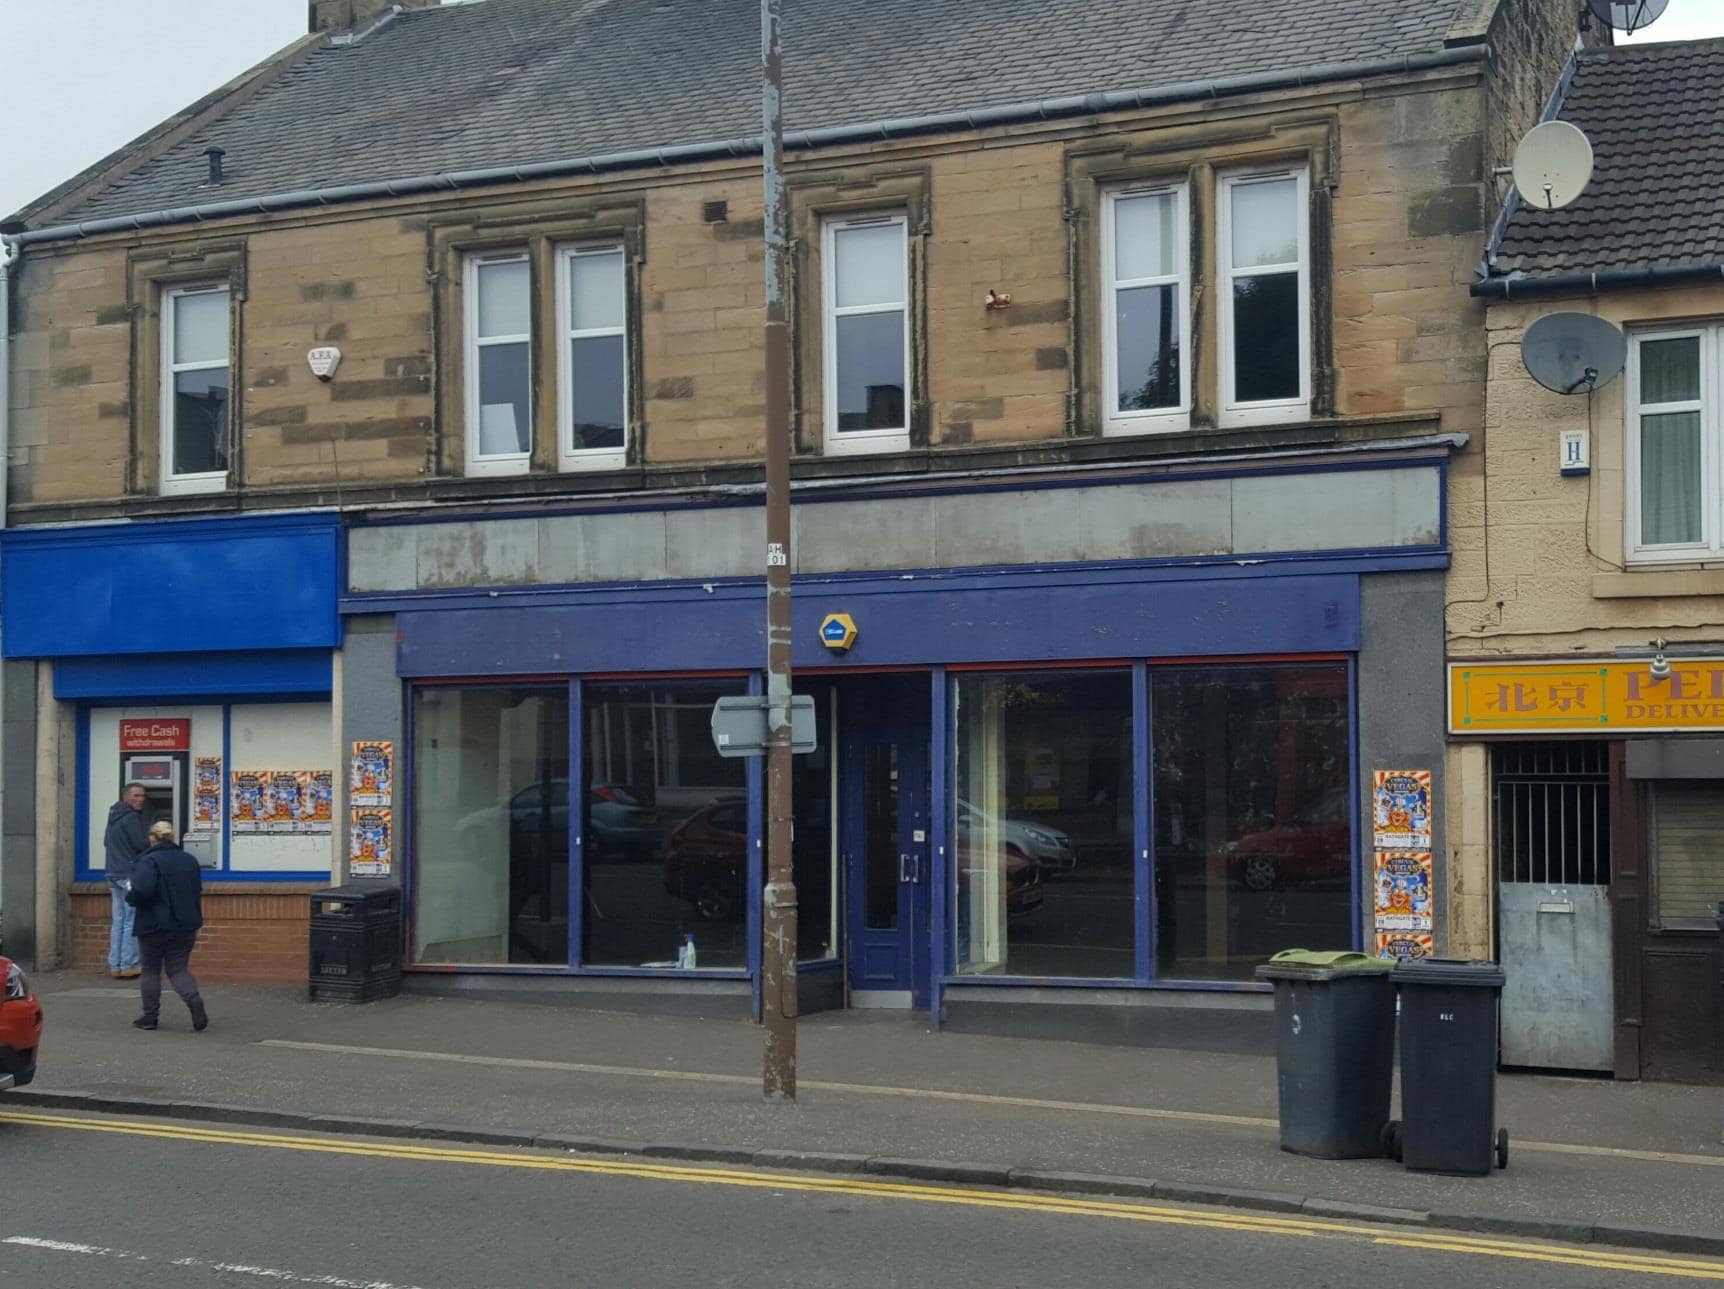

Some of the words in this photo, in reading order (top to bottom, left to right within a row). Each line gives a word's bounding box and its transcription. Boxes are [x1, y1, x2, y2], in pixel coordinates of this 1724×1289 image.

[1485, 681, 1589, 712] 北京
[1626, 703, 1724, 720] DELIVE
[124, 725, 149, 737] Free
[151, 725, 180, 737] Cash
[1387, 783, 1418, 791] VEGAS
[1388, 865, 1418, 873] VEGAS
[1389, 946, 1420, 954] VEGAS
